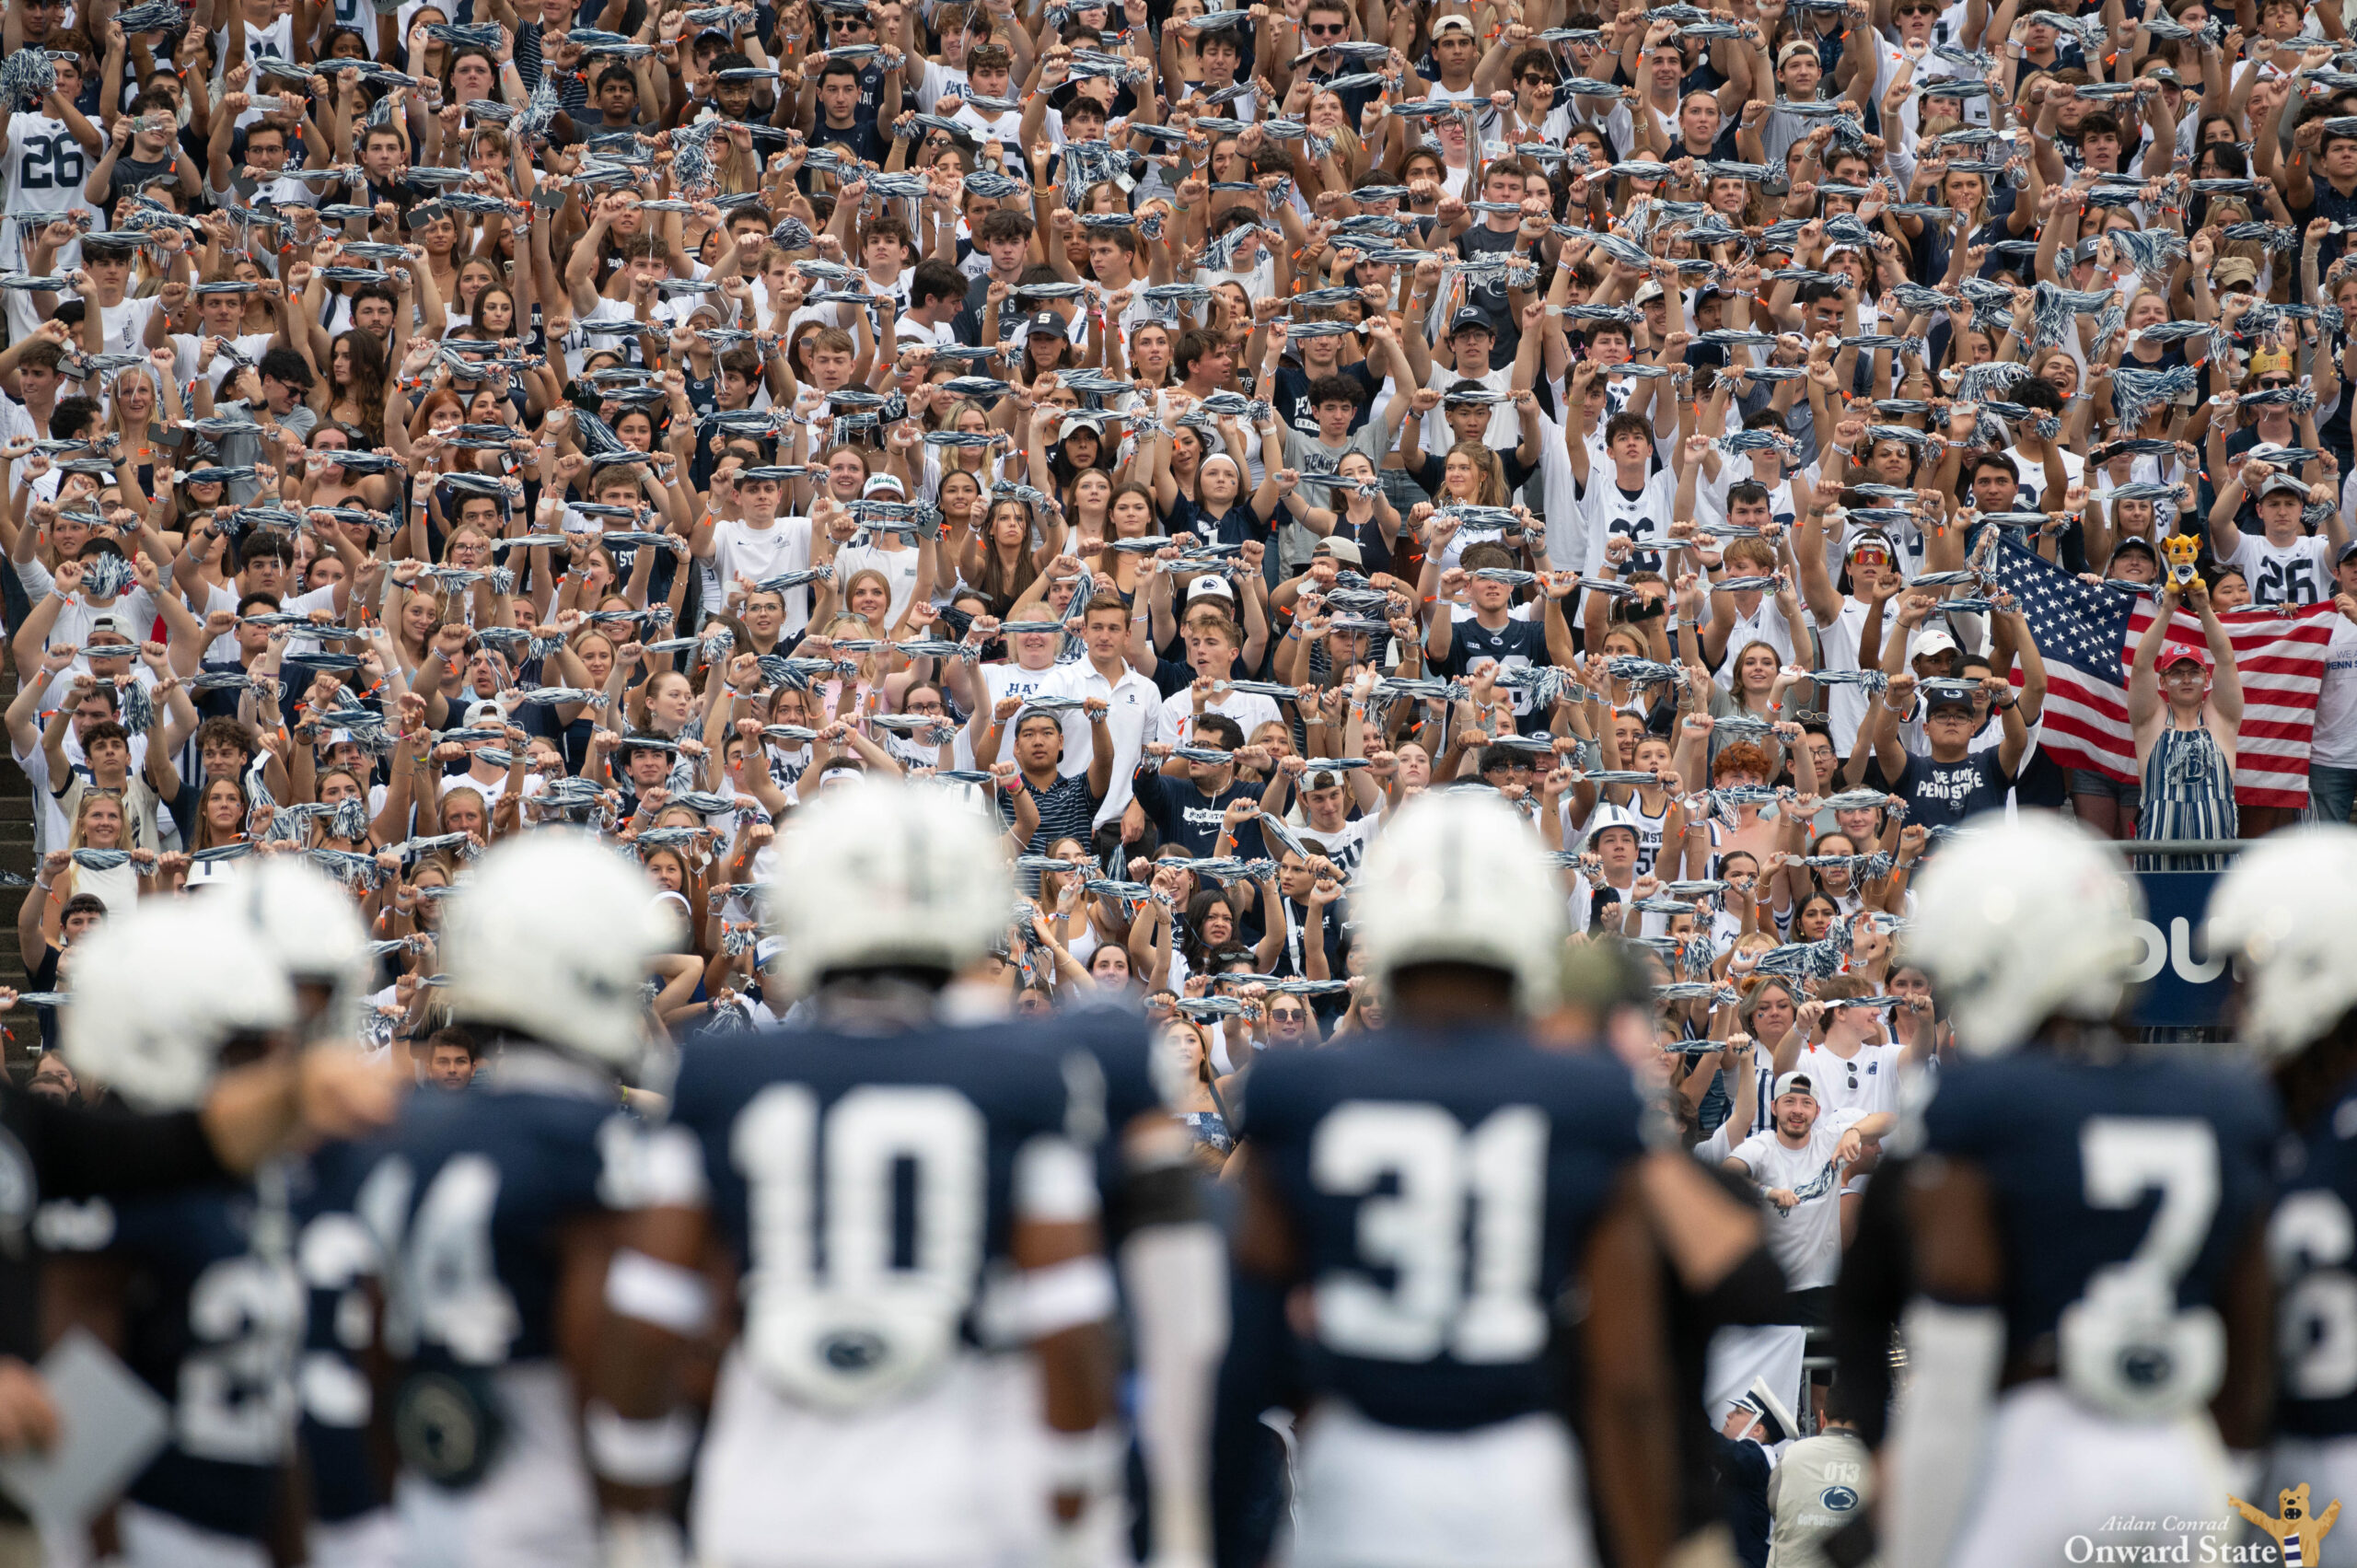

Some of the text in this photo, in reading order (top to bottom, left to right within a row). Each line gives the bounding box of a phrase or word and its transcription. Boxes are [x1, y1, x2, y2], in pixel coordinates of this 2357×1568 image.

[20, 131, 85, 189] 26
[1037, 312, 1052, 324] S
[2255, 555, 2320, 606] 26
[727, 1081, 991, 1298] 10
[2078, 1114, 2223, 1294] 7
[1307, 1098, 1554, 1365] 31
[1825, 1461, 1859, 1483] 013
